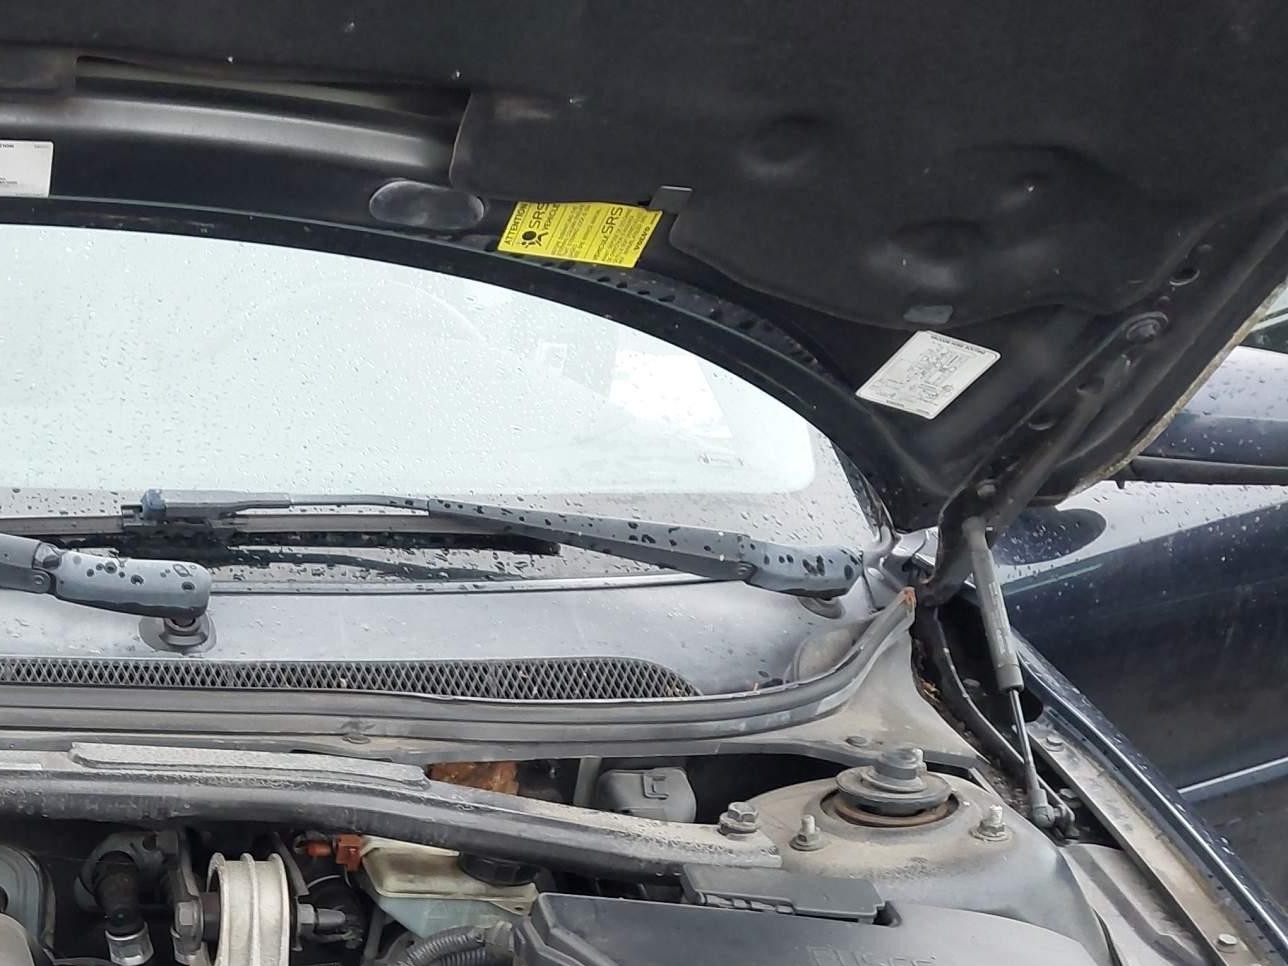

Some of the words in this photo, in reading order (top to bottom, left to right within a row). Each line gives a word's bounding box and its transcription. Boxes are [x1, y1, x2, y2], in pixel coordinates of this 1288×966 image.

[503, 203, 529, 246] ATTENTION
[528, 202, 550, 230] SRS
[601, 206, 624, 234] SRS
